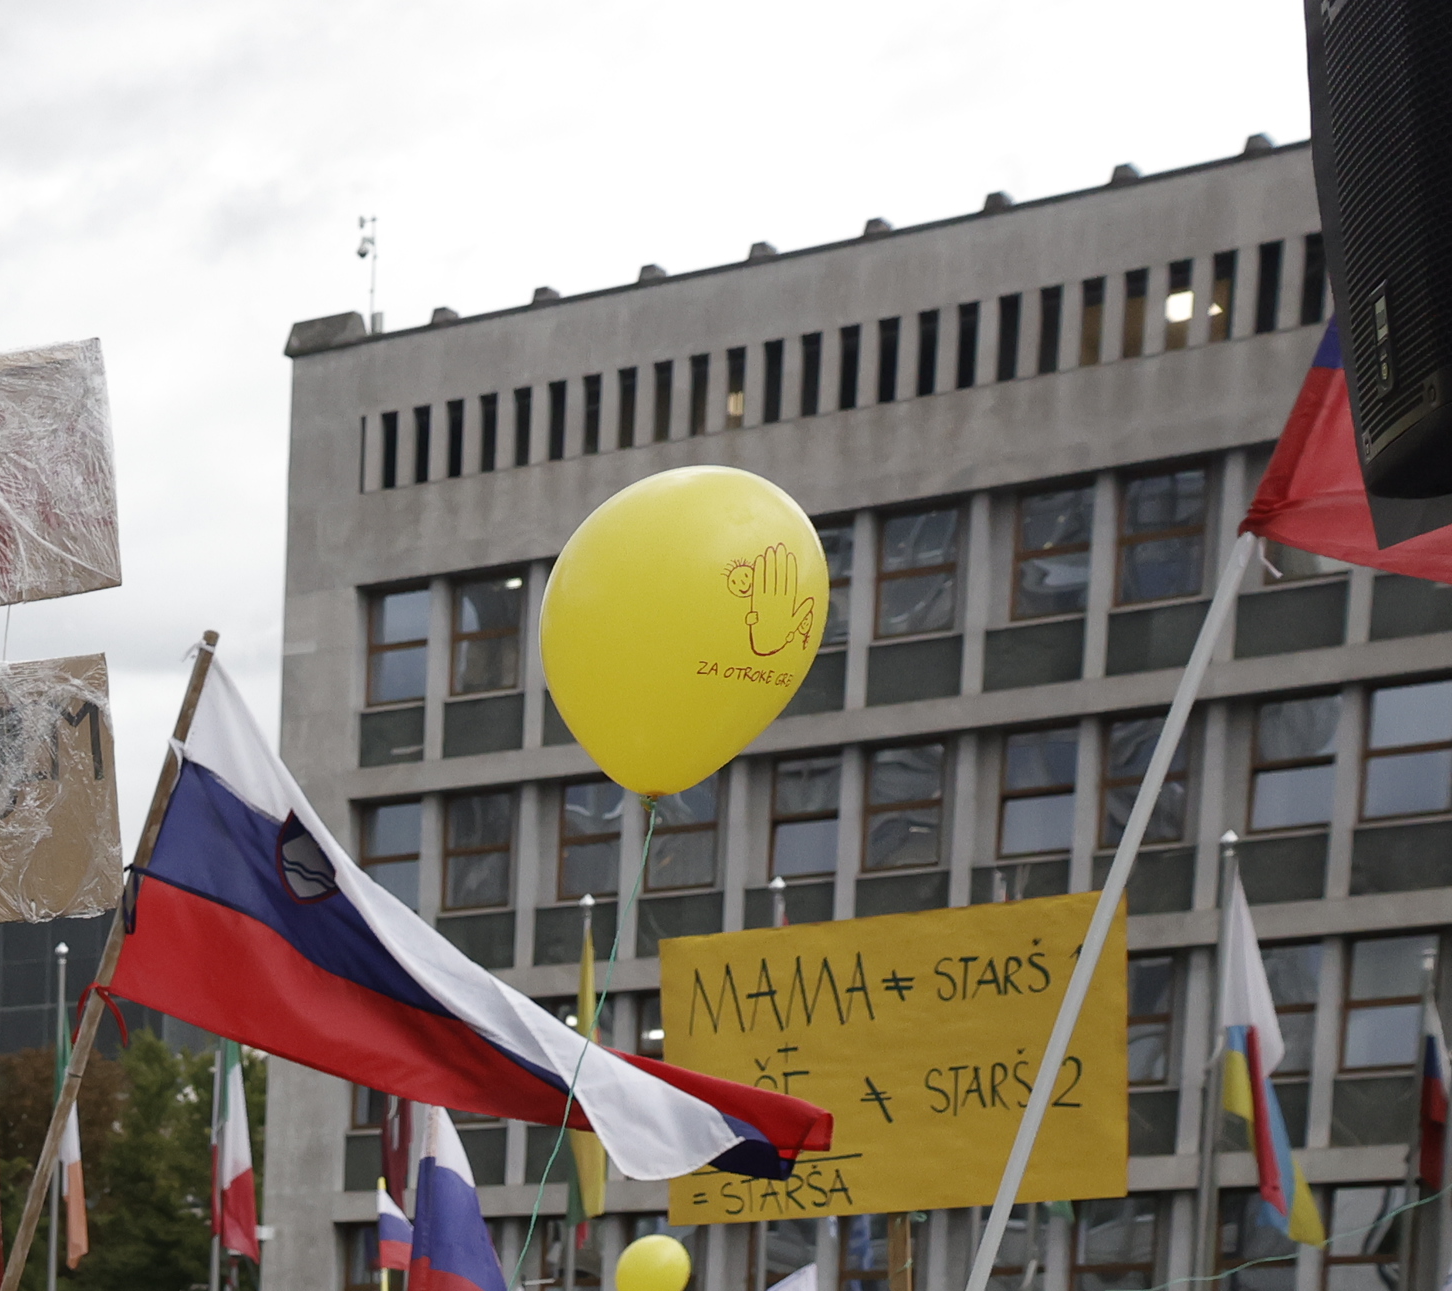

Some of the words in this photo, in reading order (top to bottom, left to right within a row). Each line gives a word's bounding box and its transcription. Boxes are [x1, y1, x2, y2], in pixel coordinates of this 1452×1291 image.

[697, 661, 719, 676] ZA
[723, 666, 775, 686] OTROKE
[689, 952, 875, 1036] MAMA
[934, 938, 1051, 1002] STARŠ
[924, 1049, 1033, 1116] STARŠ
[1051, 1056, 1084, 1108] 2
[720, 1162, 854, 1215] STARŠA
